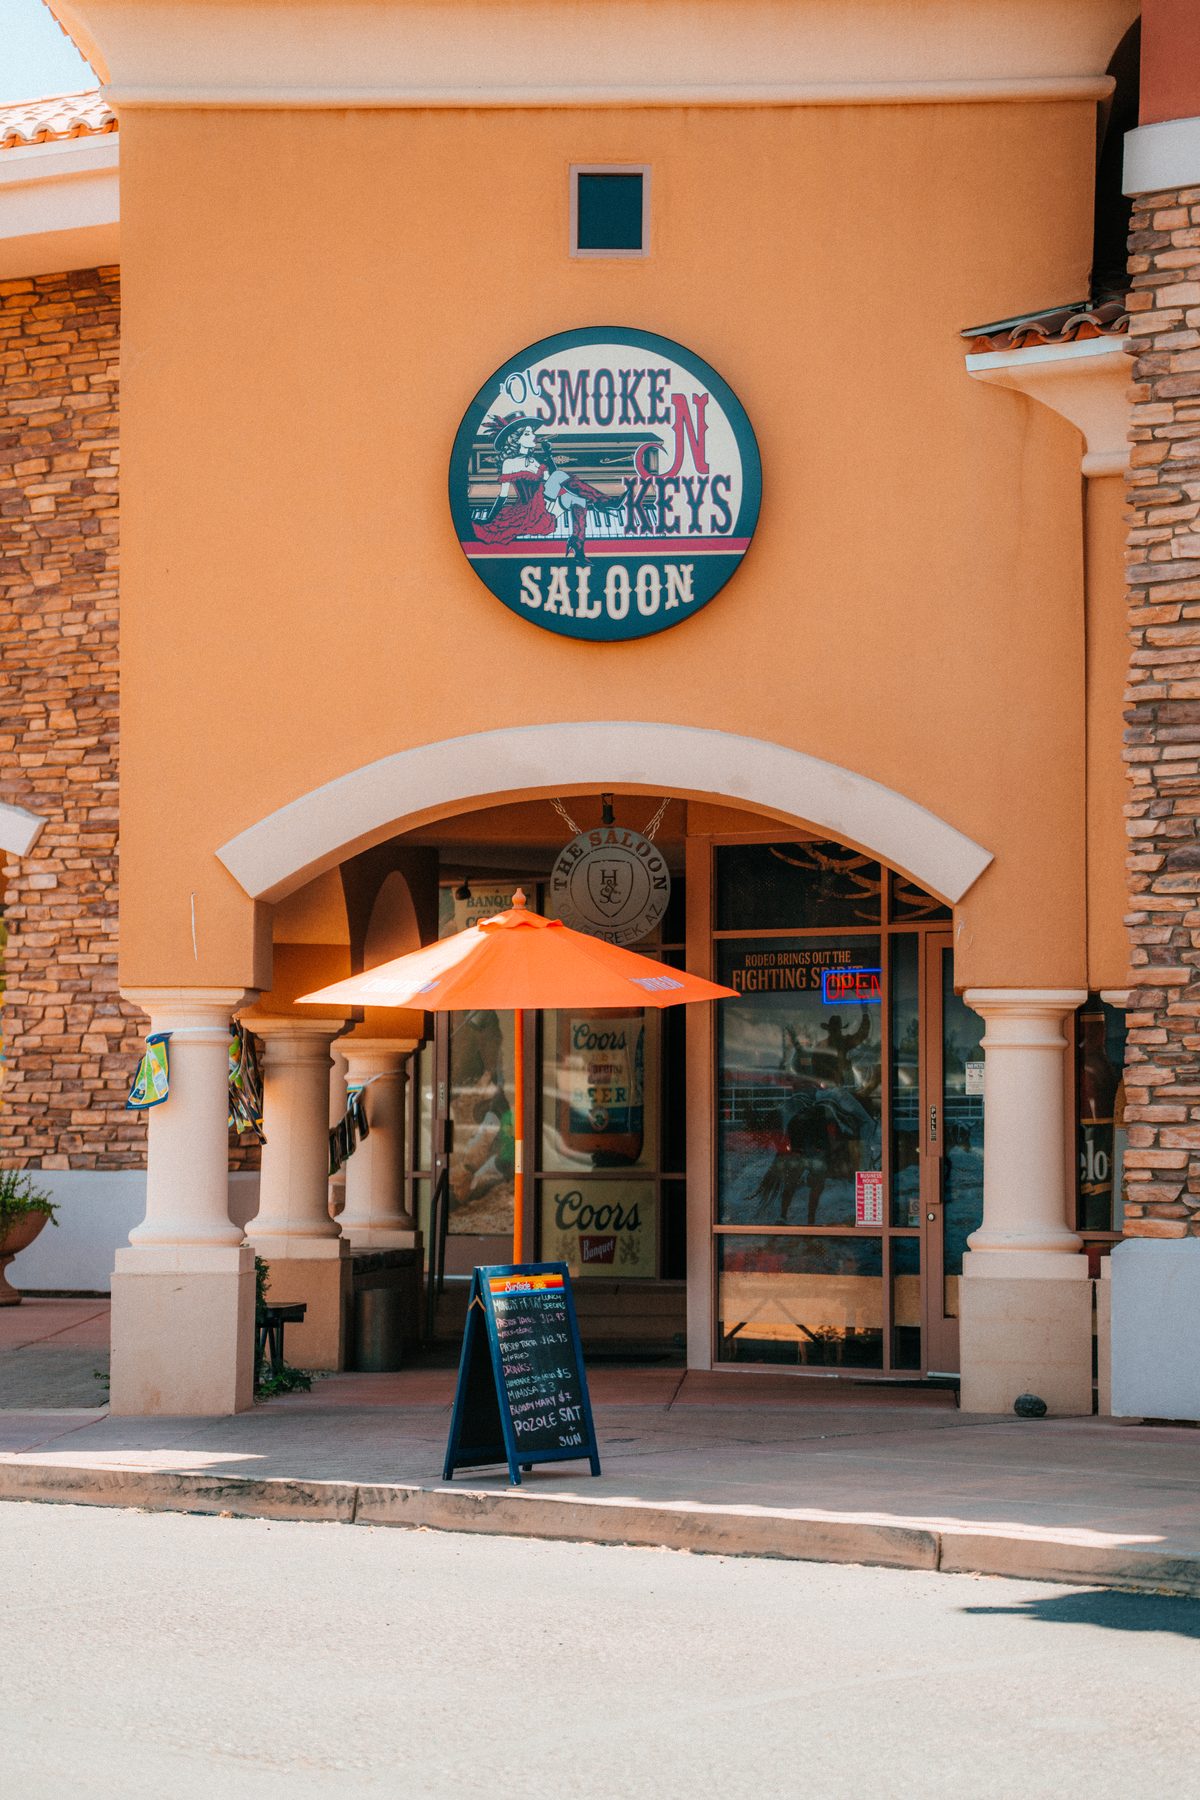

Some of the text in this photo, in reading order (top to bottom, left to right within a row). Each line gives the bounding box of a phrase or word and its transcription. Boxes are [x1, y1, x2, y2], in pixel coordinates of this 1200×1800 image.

[536, 368, 672, 427] SMOKE
[634, 392, 710, 479] N
[622, 474, 734, 535] KEYS
[519, 563, 695, 620] SALOON
[554, 830, 668, 891] THE SALOON
[645, 903, 663, 926] AZ
[745, 950, 851, 967] RODEO BRINGS OUT THE
[732, 968, 806, 992] FIGHTING
[826, 974, 881, 999] OPEN
[573, 1024, 627, 1050] Coors
[554, 1191, 641, 1231] Coors
[583, 1239, 614, 1261] Banquet
[505, 1281, 531, 1292] Surfside
[513, 1405, 581, 1437] POZOLE SAT
[559, 1432, 582, 1447] SUN
